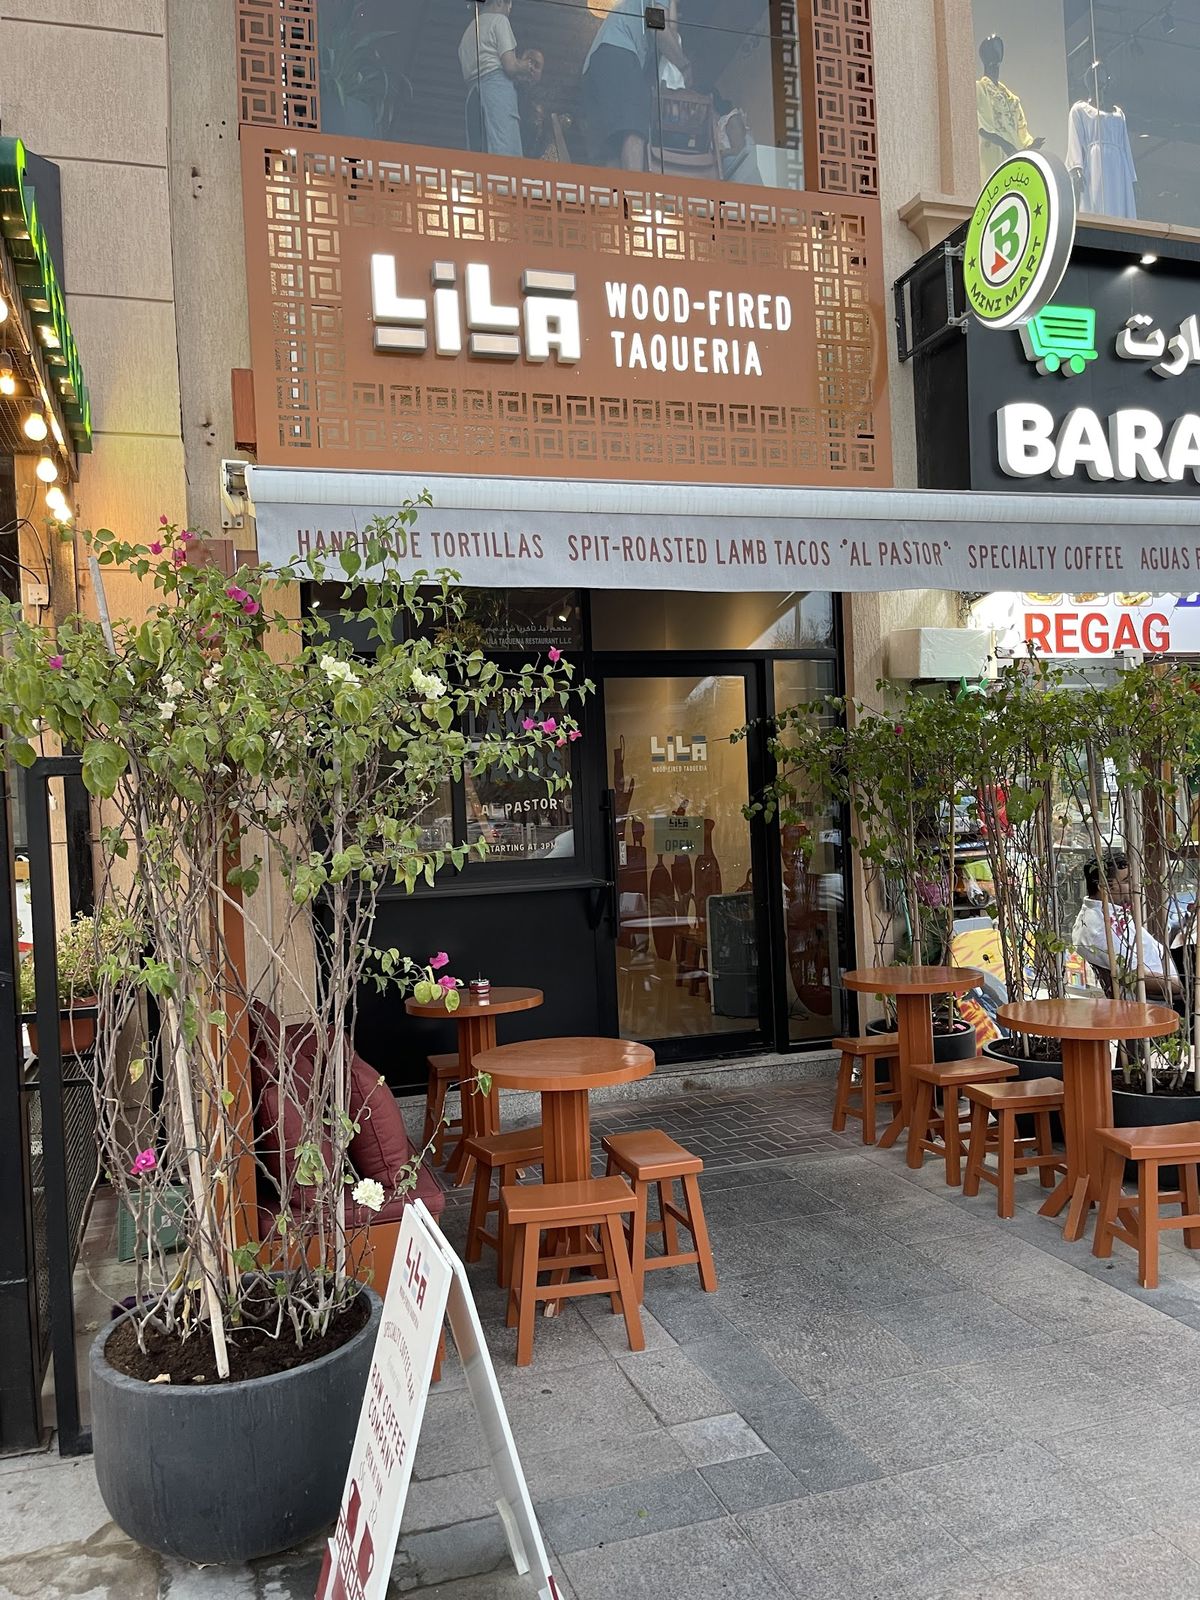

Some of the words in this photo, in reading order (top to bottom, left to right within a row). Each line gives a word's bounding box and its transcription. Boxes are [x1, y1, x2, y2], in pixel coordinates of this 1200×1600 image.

[970, 281, 1002, 312] MINI
[1005, 235, 1042, 307] MART
[604, 281, 792, 332] WOOD-FIRED
[610, 330, 763, 377] TAQUERIA
[430, 531, 545, 559] TORTILLAS
[567, 534, 708, 564] SPIT-ROASTED
[715, 539, 768, 566] LAMB
[773, 539, 831, 567] TACOS
[967, 545, 1056, 570] SPECIALTY
[1064, 545, 1124, 570] COFFEE
[1140, 546, 1190, 570] AGUAS
[525, 637, 558, 645] RESTAURANT
[1024, 612, 1171, 654] REGAG
[527, 843, 538, 851] AT
[399, 1336, 411, 1378] COFFEE
[407, 1371, 415, 1407] BAR
[368, 1397, 395, 1479] COMPANY
[371, 1362, 385, 1404] RAW
[383, 1394, 406, 1467] COFFEE
